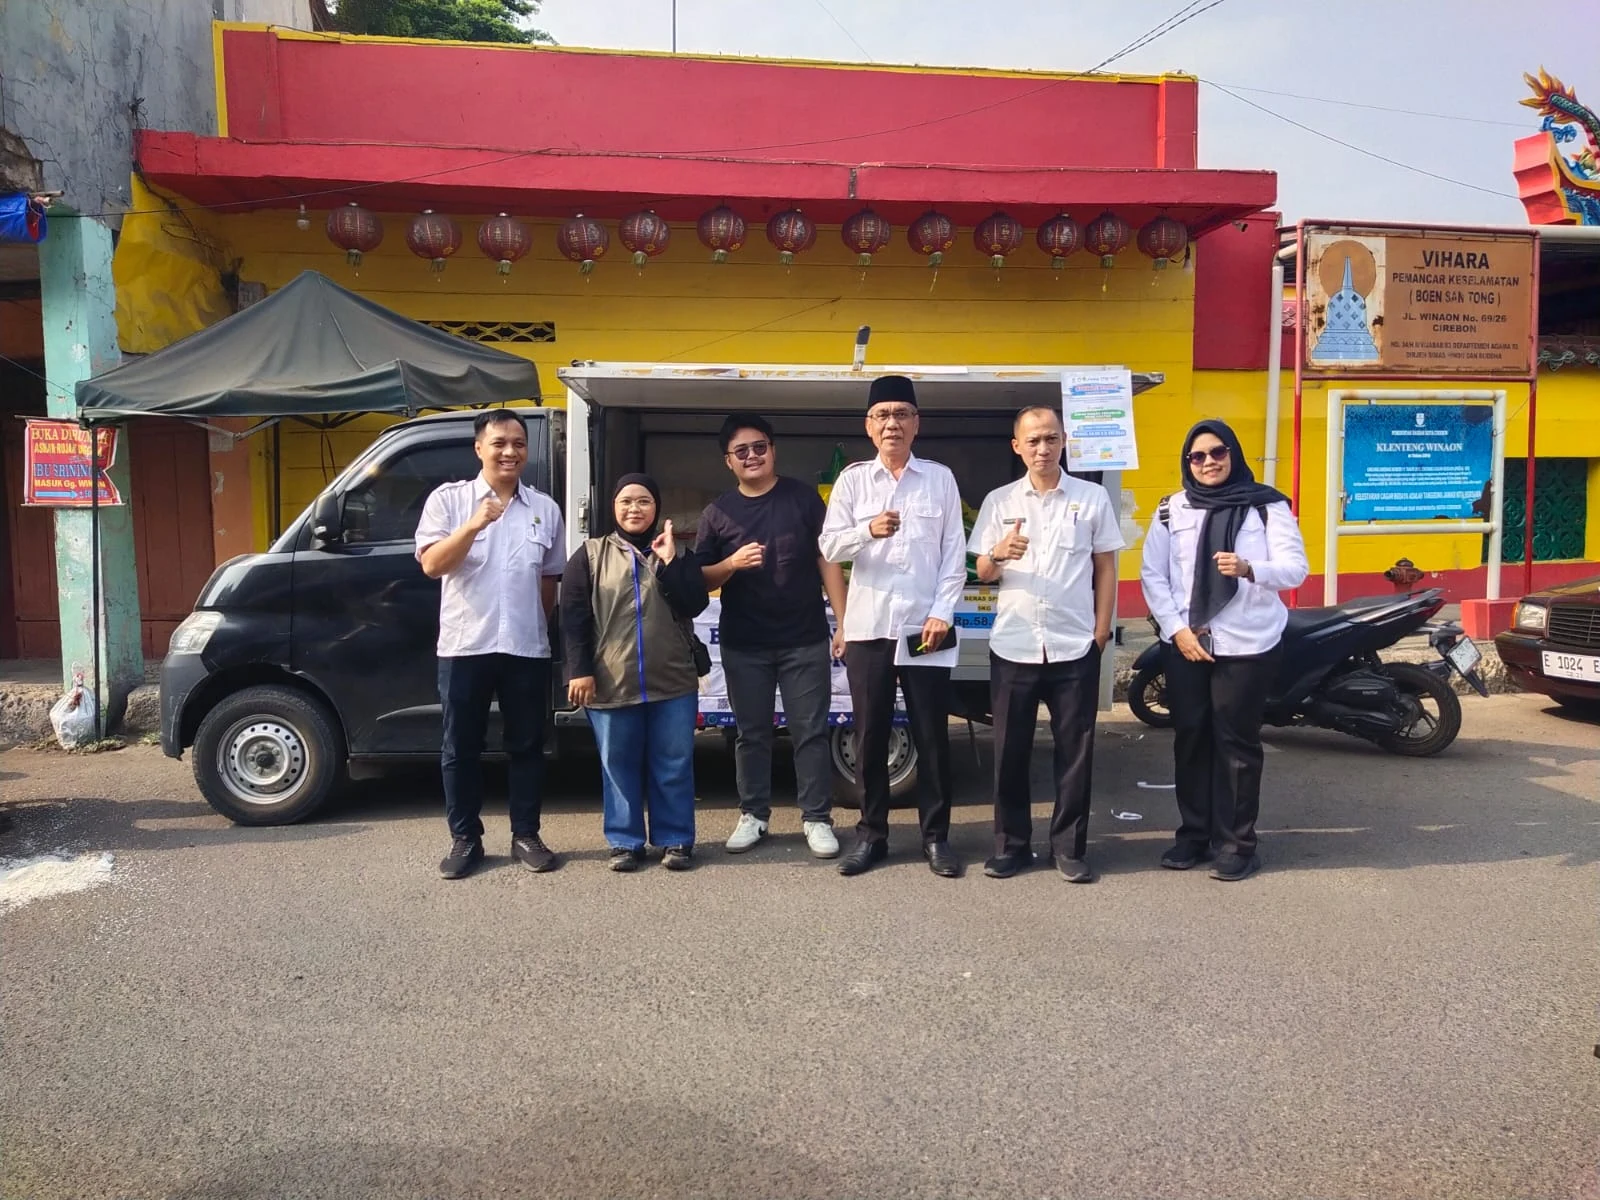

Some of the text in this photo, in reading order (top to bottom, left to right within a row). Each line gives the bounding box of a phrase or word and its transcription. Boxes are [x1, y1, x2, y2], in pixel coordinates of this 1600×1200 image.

[1422, 250, 1490, 270] VIHARA
[1392, 272, 1520, 287] PEMANCAR KESELAMATAN
[1415, 290, 1442, 303] BOEN
[1445, 291, 1464, 304] SAN
[1468, 291, 1495, 304] TONG
[1402, 312, 1416, 321] JL.
[1420, 313, 1460, 322] WINAON
[1462, 313, 1478, 322] No.
[1432, 324, 1477, 333] CIREBON
[31, 428, 59, 441] BUKA
[1376, 442, 1463, 452] KLENTENG WINAON
[33, 463, 51, 477] IBU
[34, 479, 63, 488] MASUK
[1544, 654, 1551, 667] E
[1557, 656, 1583, 671] 1024
